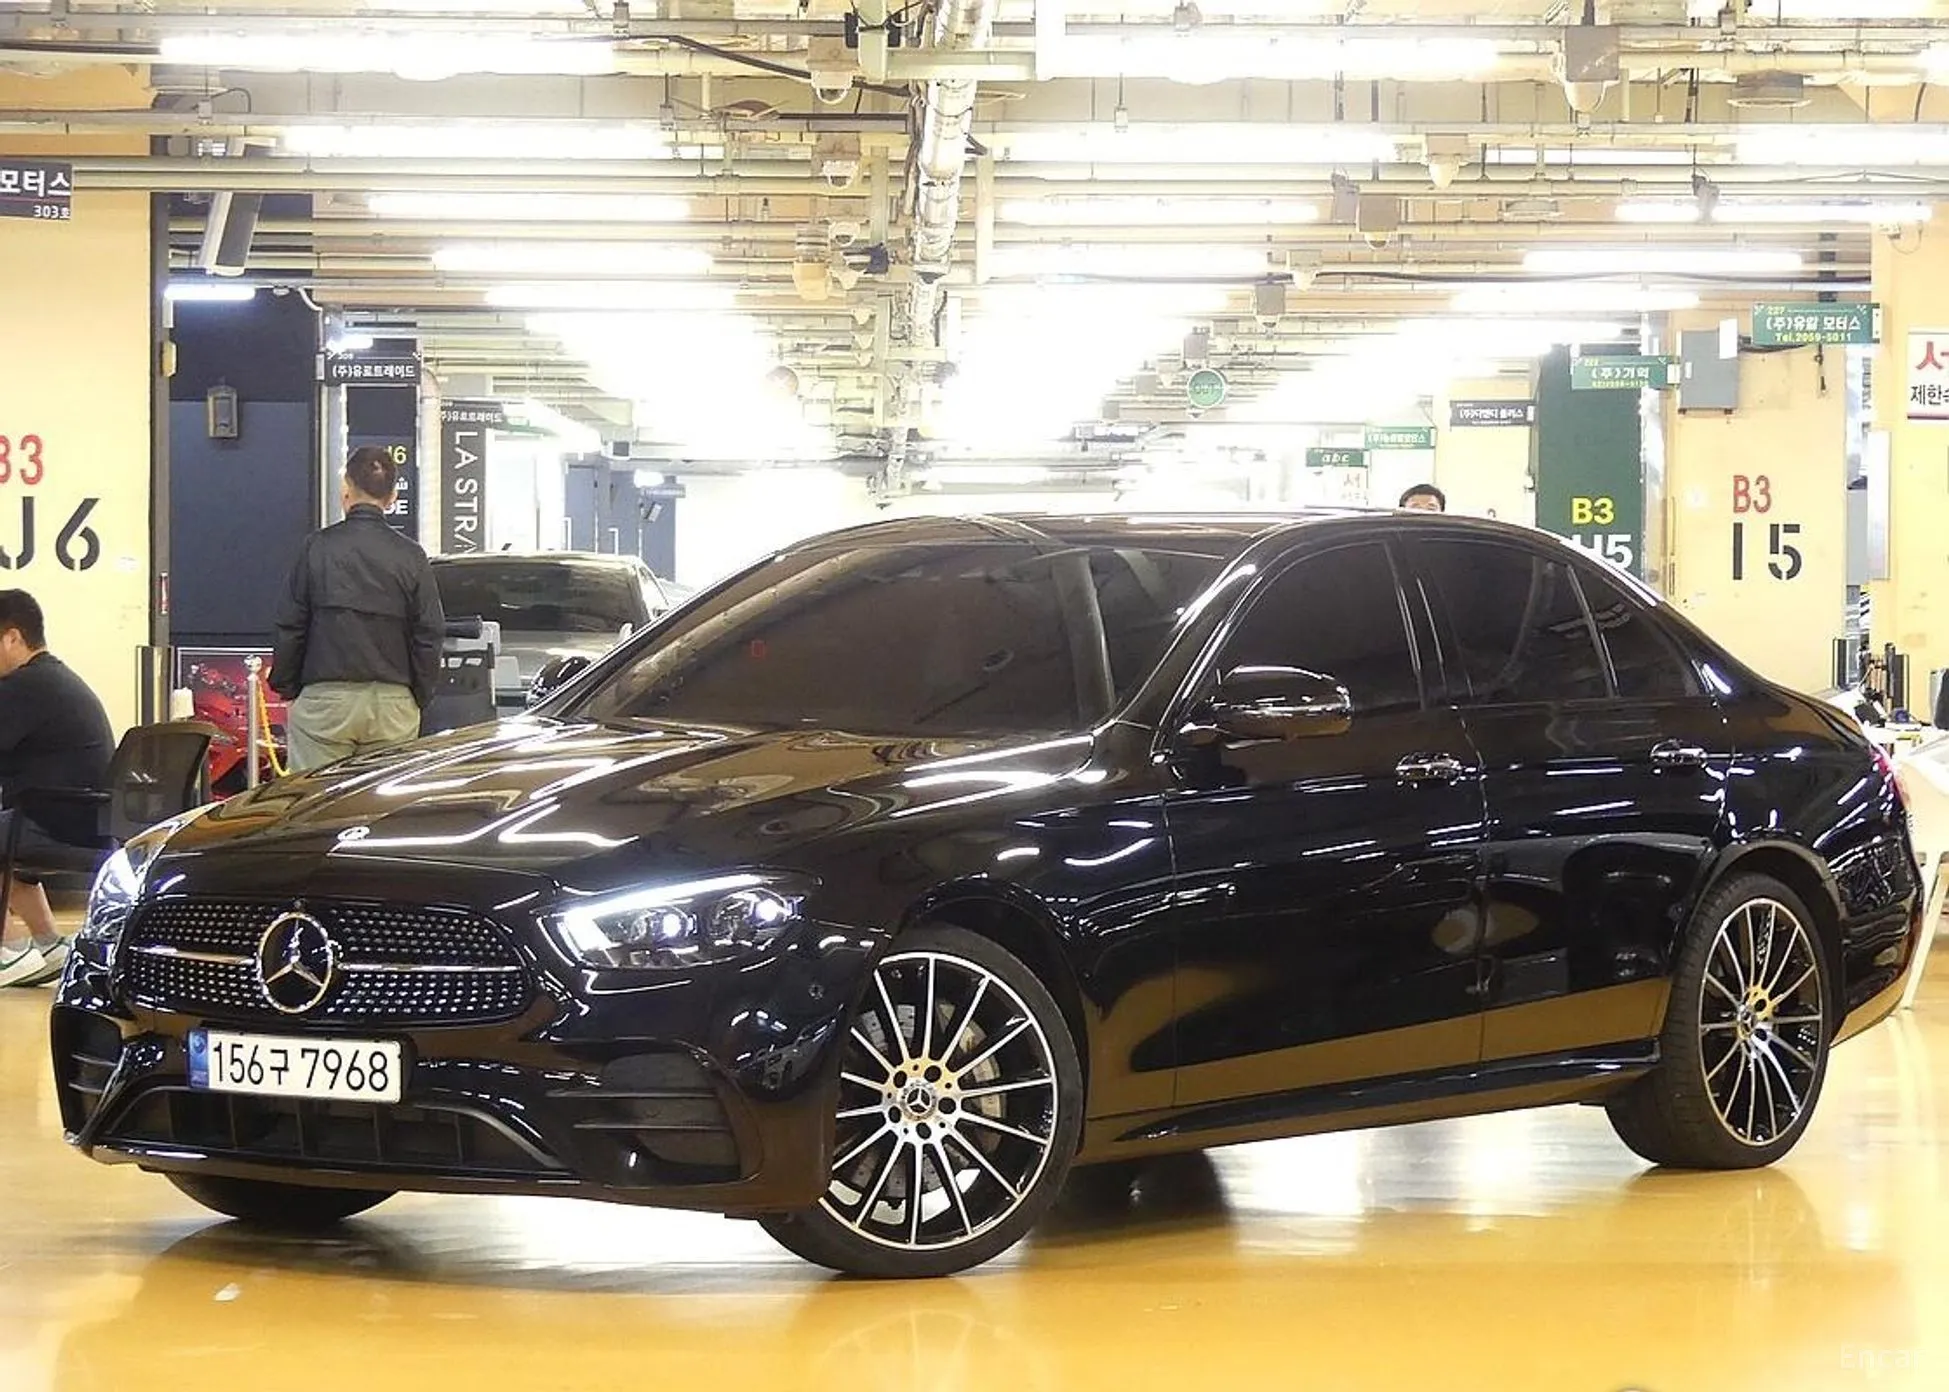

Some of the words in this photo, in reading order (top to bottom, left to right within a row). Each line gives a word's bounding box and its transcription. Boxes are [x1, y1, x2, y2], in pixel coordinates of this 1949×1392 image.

[0, 169, 71, 197] 모터스
[1571, 496, 1615, 526] B3
[1732, 474, 1772, 514] B3
[213, 1040, 290, 1086] 156구
[300, 1047, 389, 1093] 7968
